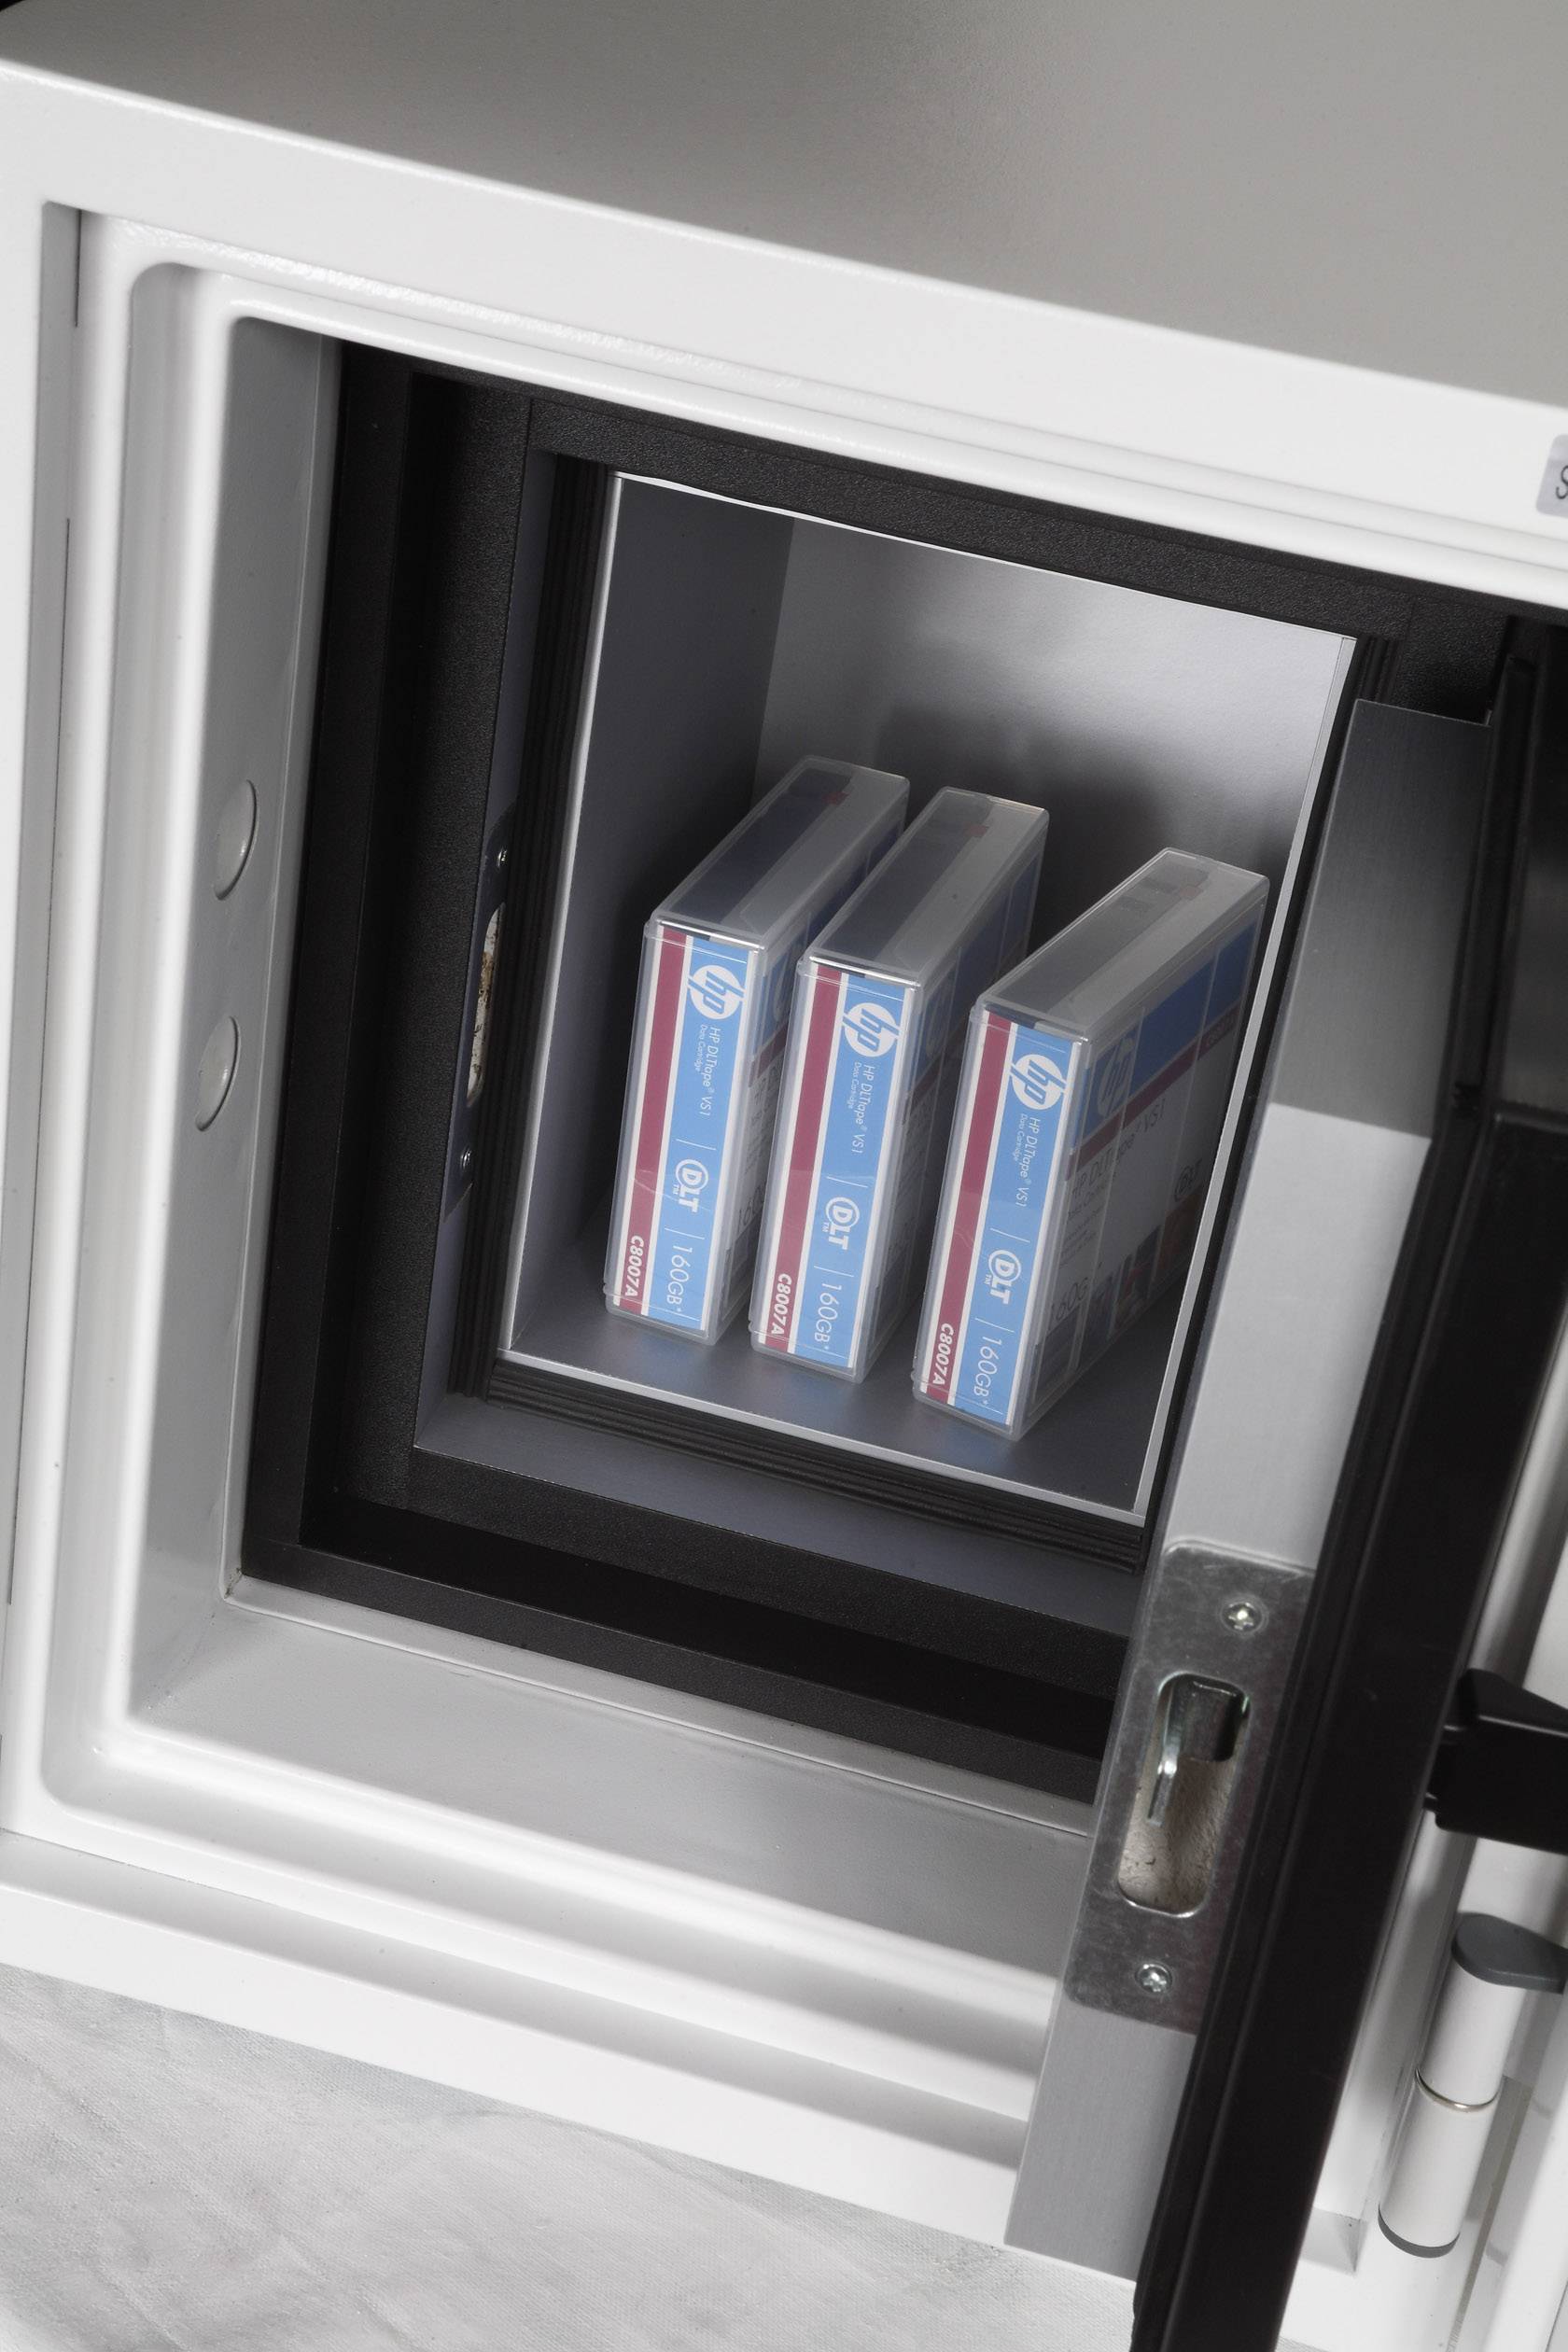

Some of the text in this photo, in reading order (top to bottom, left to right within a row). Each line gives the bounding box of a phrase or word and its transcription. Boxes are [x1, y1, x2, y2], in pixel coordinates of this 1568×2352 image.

[709, 1027, 721, 1044] HP
[863, 1063, 875, 1082] HP
[700, 1096, 713, 1116] VS1
[1029, 1116, 1041, 1134] HP
[851, 1133, 866, 1154] VS1
[675, 1158, 708, 1213] DLT
[1015, 1186, 1029, 1208] VS1
[825, 1197, 861, 1251] DLT
[624, 1234, 644, 1297] C8007A
[988, 1249, 1021, 1305] DLT
[771, 1273, 792, 1336] C8007A
[932, 1323, 955, 1385] C8007A
